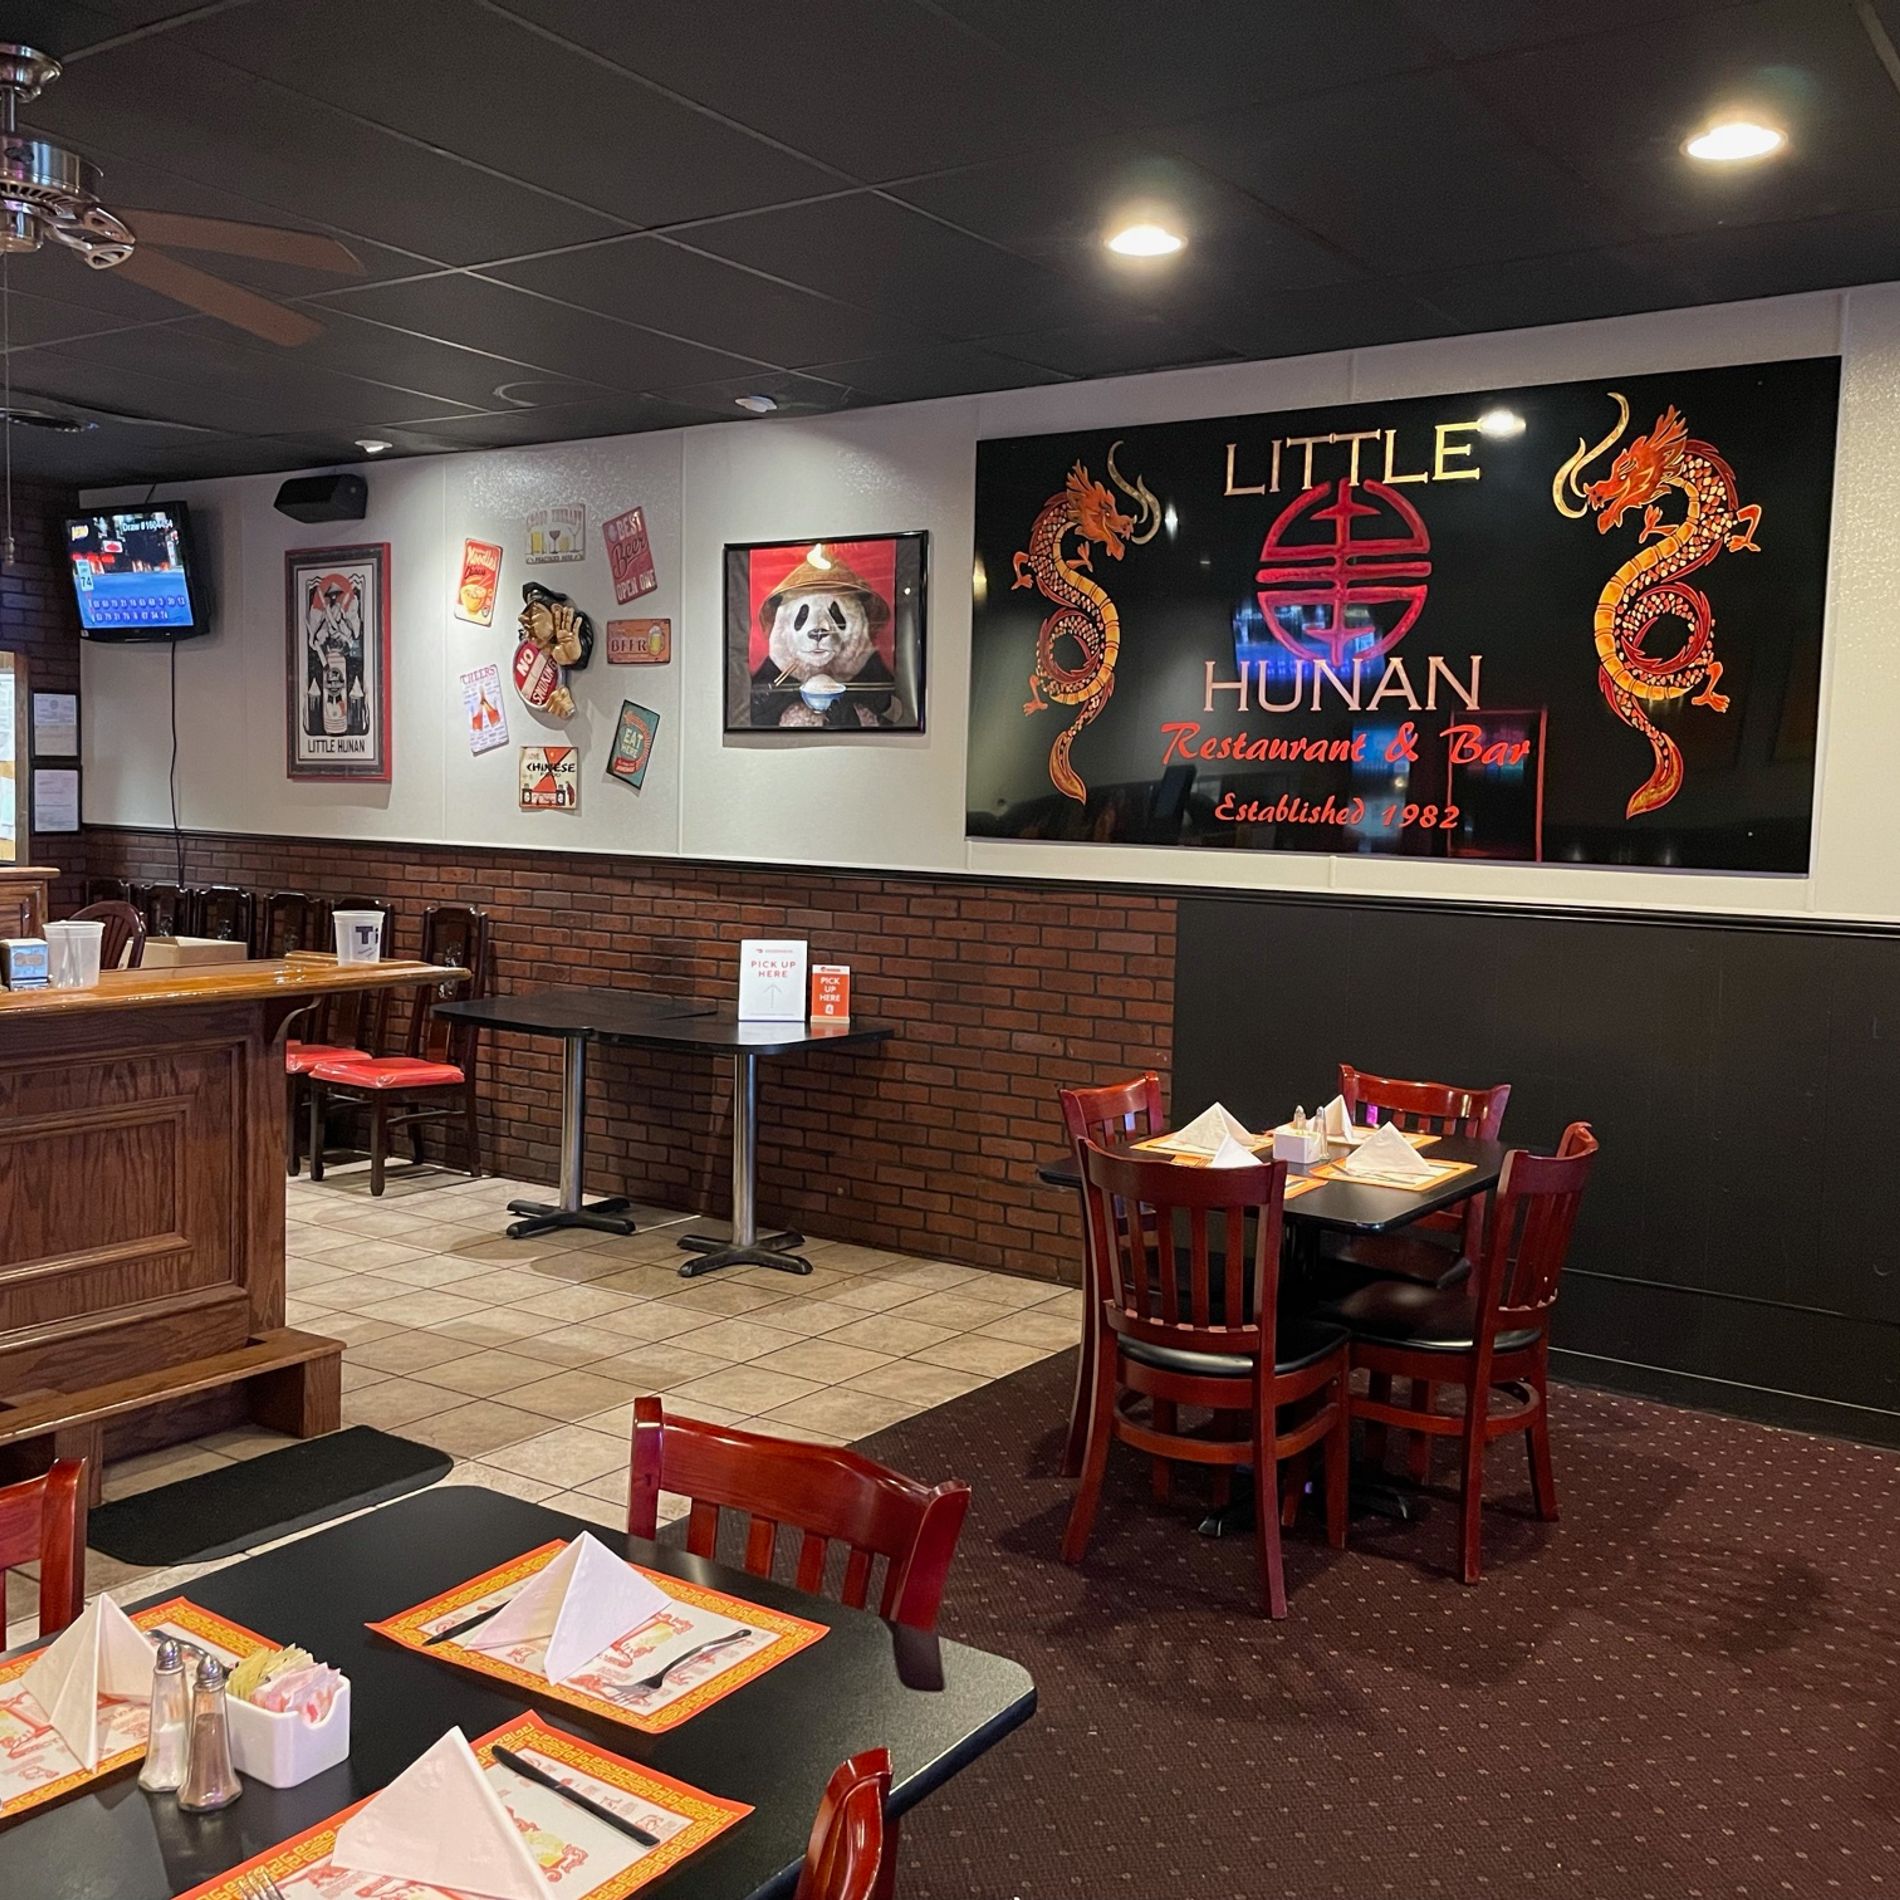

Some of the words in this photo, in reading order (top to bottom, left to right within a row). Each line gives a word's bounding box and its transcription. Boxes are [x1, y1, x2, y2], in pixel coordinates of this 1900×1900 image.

[1224, 418, 1482, 496] LITTLE
[616, 511, 642, 541] BEST
[612, 536, 647, 579] Beer
[616, 577, 639, 601] OPEN
[639, 569, 656, 590] ONE
[516, 648, 536, 677] NO
[460, 666, 496, 685] CHEERS
[532, 657, 558, 705] SMOKING
[1203, 655, 1482, 712] HUNAN
[308, 739, 335, 753] LITTLE
[337, 739, 365, 753] HUNAN
[623, 728, 644, 749] EAT
[1161, 721, 1367, 765] Restaurant
[1384, 721, 1420, 763] &
[1440, 723, 1531, 766] Bar
[620, 744, 639, 759] HERE
[526, 762, 577, 773] CHINESE
[1214, 791, 1366, 827] Established
[1381, 804, 1460, 830] 1982
[750, 960, 777, 969] PICK
[781, 960, 797, 969] UP
[758, 970, 789, 978] HERE
[820, 976, 840, 985] PICK
[819, 994, 841, 1002] HERE
